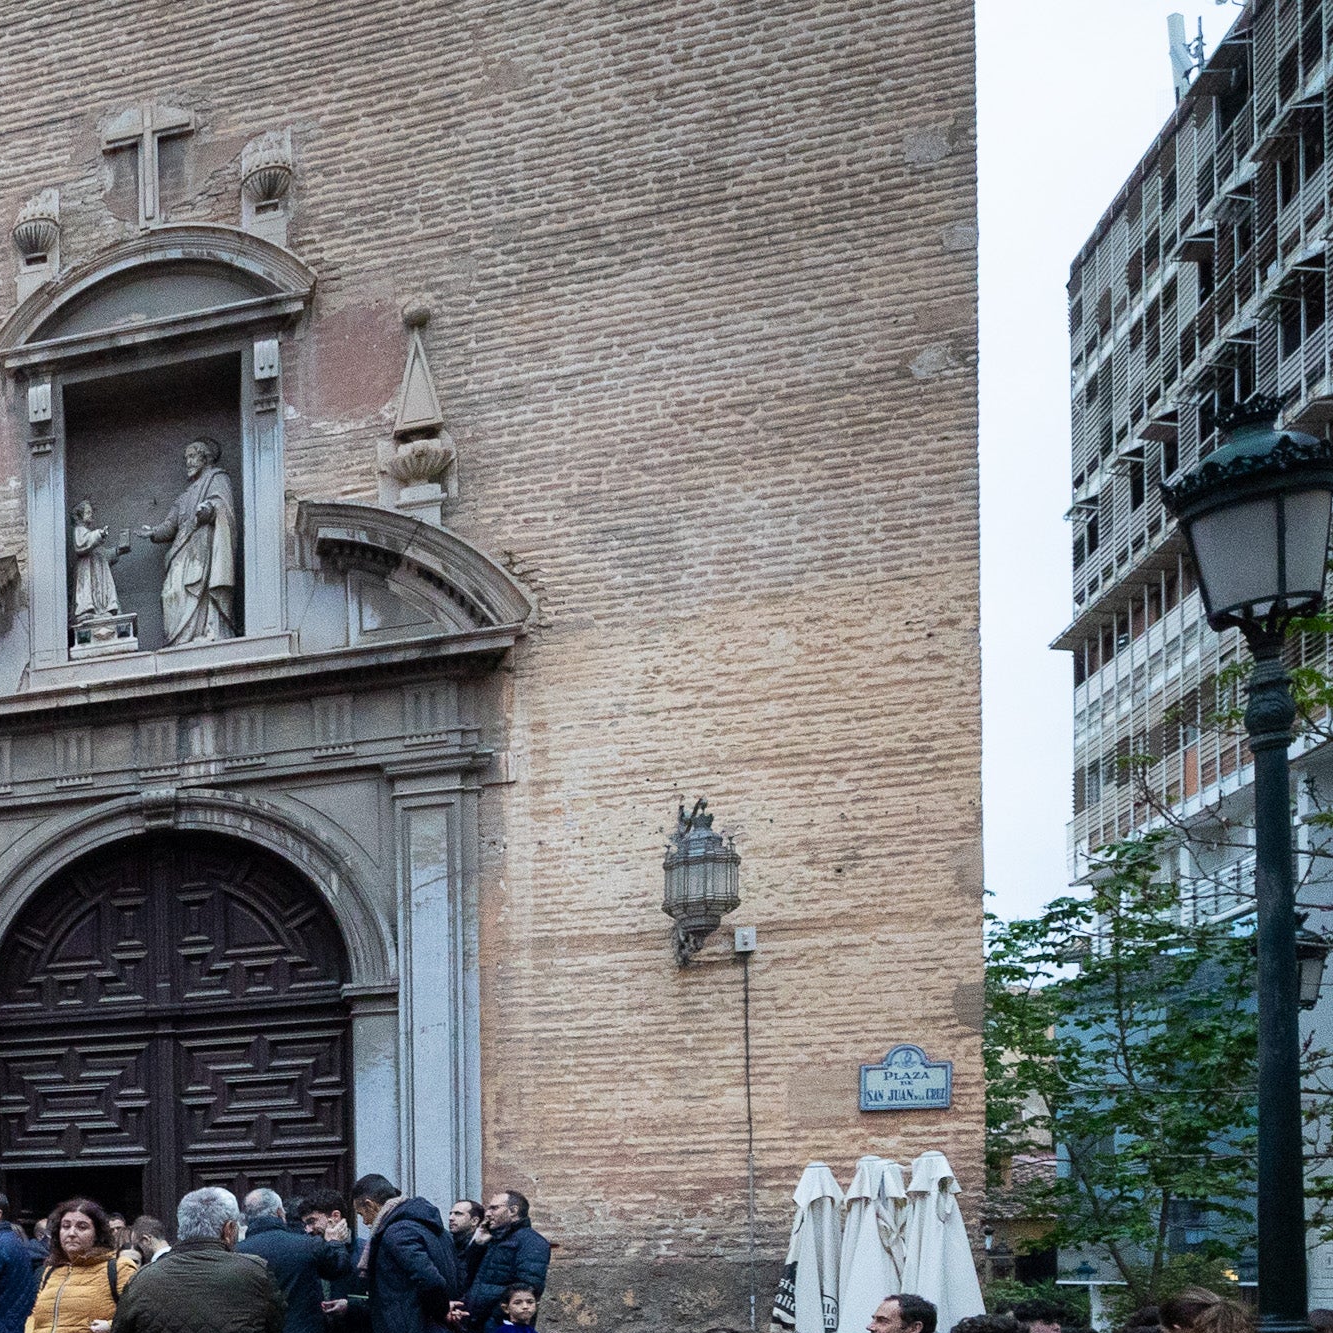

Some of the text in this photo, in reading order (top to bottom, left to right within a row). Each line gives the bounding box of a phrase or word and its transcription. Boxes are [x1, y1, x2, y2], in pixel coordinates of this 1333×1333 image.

[884, 1071, 930, 1080] PLAZA
[867, 1090, 884, 1102] SAN
[888, 1088, 914, 1101] JUAN
